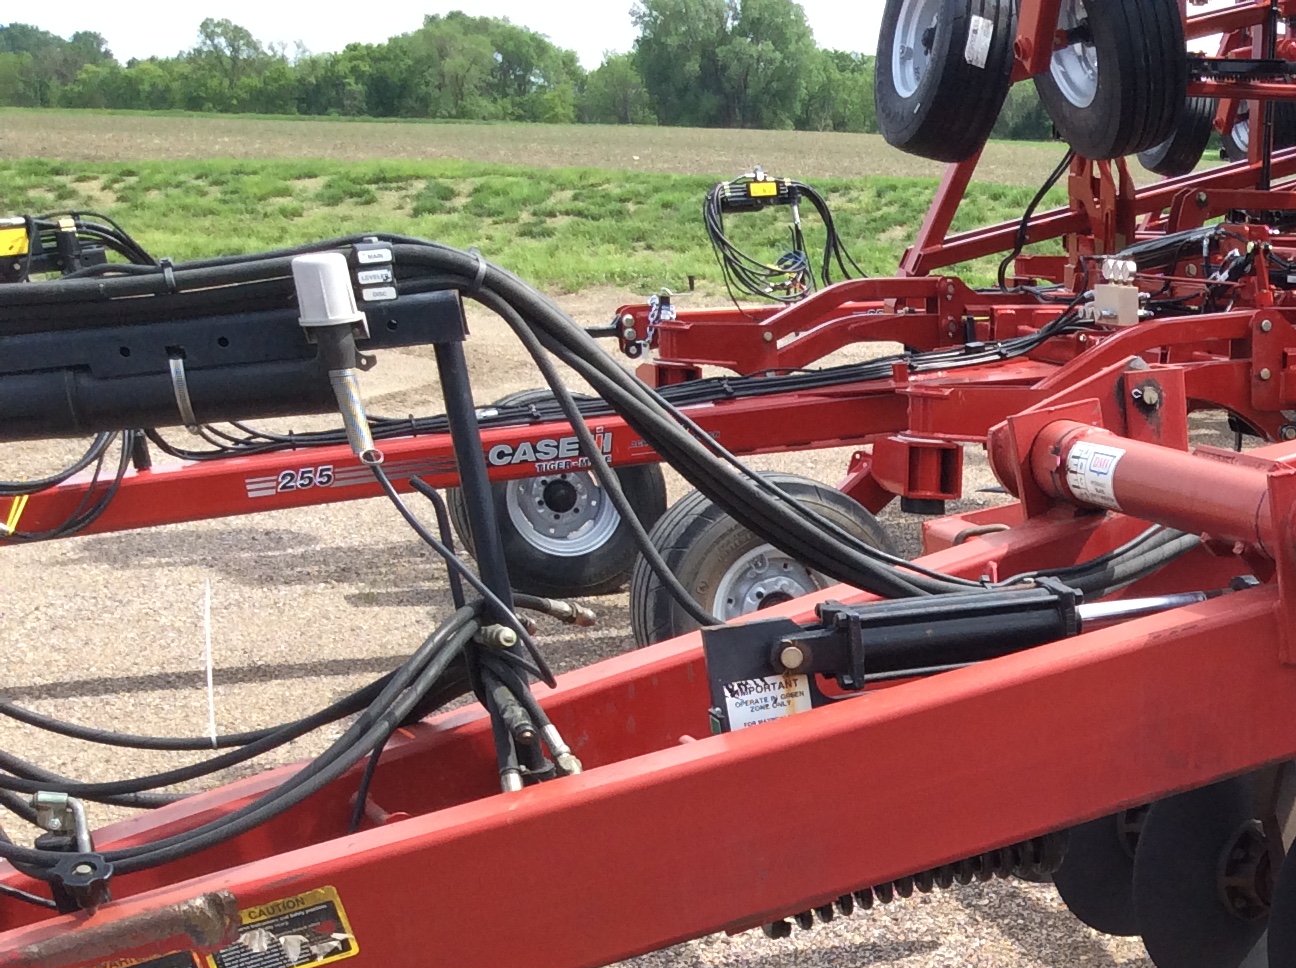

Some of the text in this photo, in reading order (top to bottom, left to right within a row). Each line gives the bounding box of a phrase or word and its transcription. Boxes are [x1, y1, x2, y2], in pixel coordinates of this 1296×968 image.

[488, 437, 580, 466] CASE
[535, 454, 612, 473] TIGER-ME
[276, 465, 335, 493] 255
[735, 696, 769, 708] OPERATE
[750, 700, 792, 713] ZONE ONLY
[247, 896, 306, 921] CAUTION
